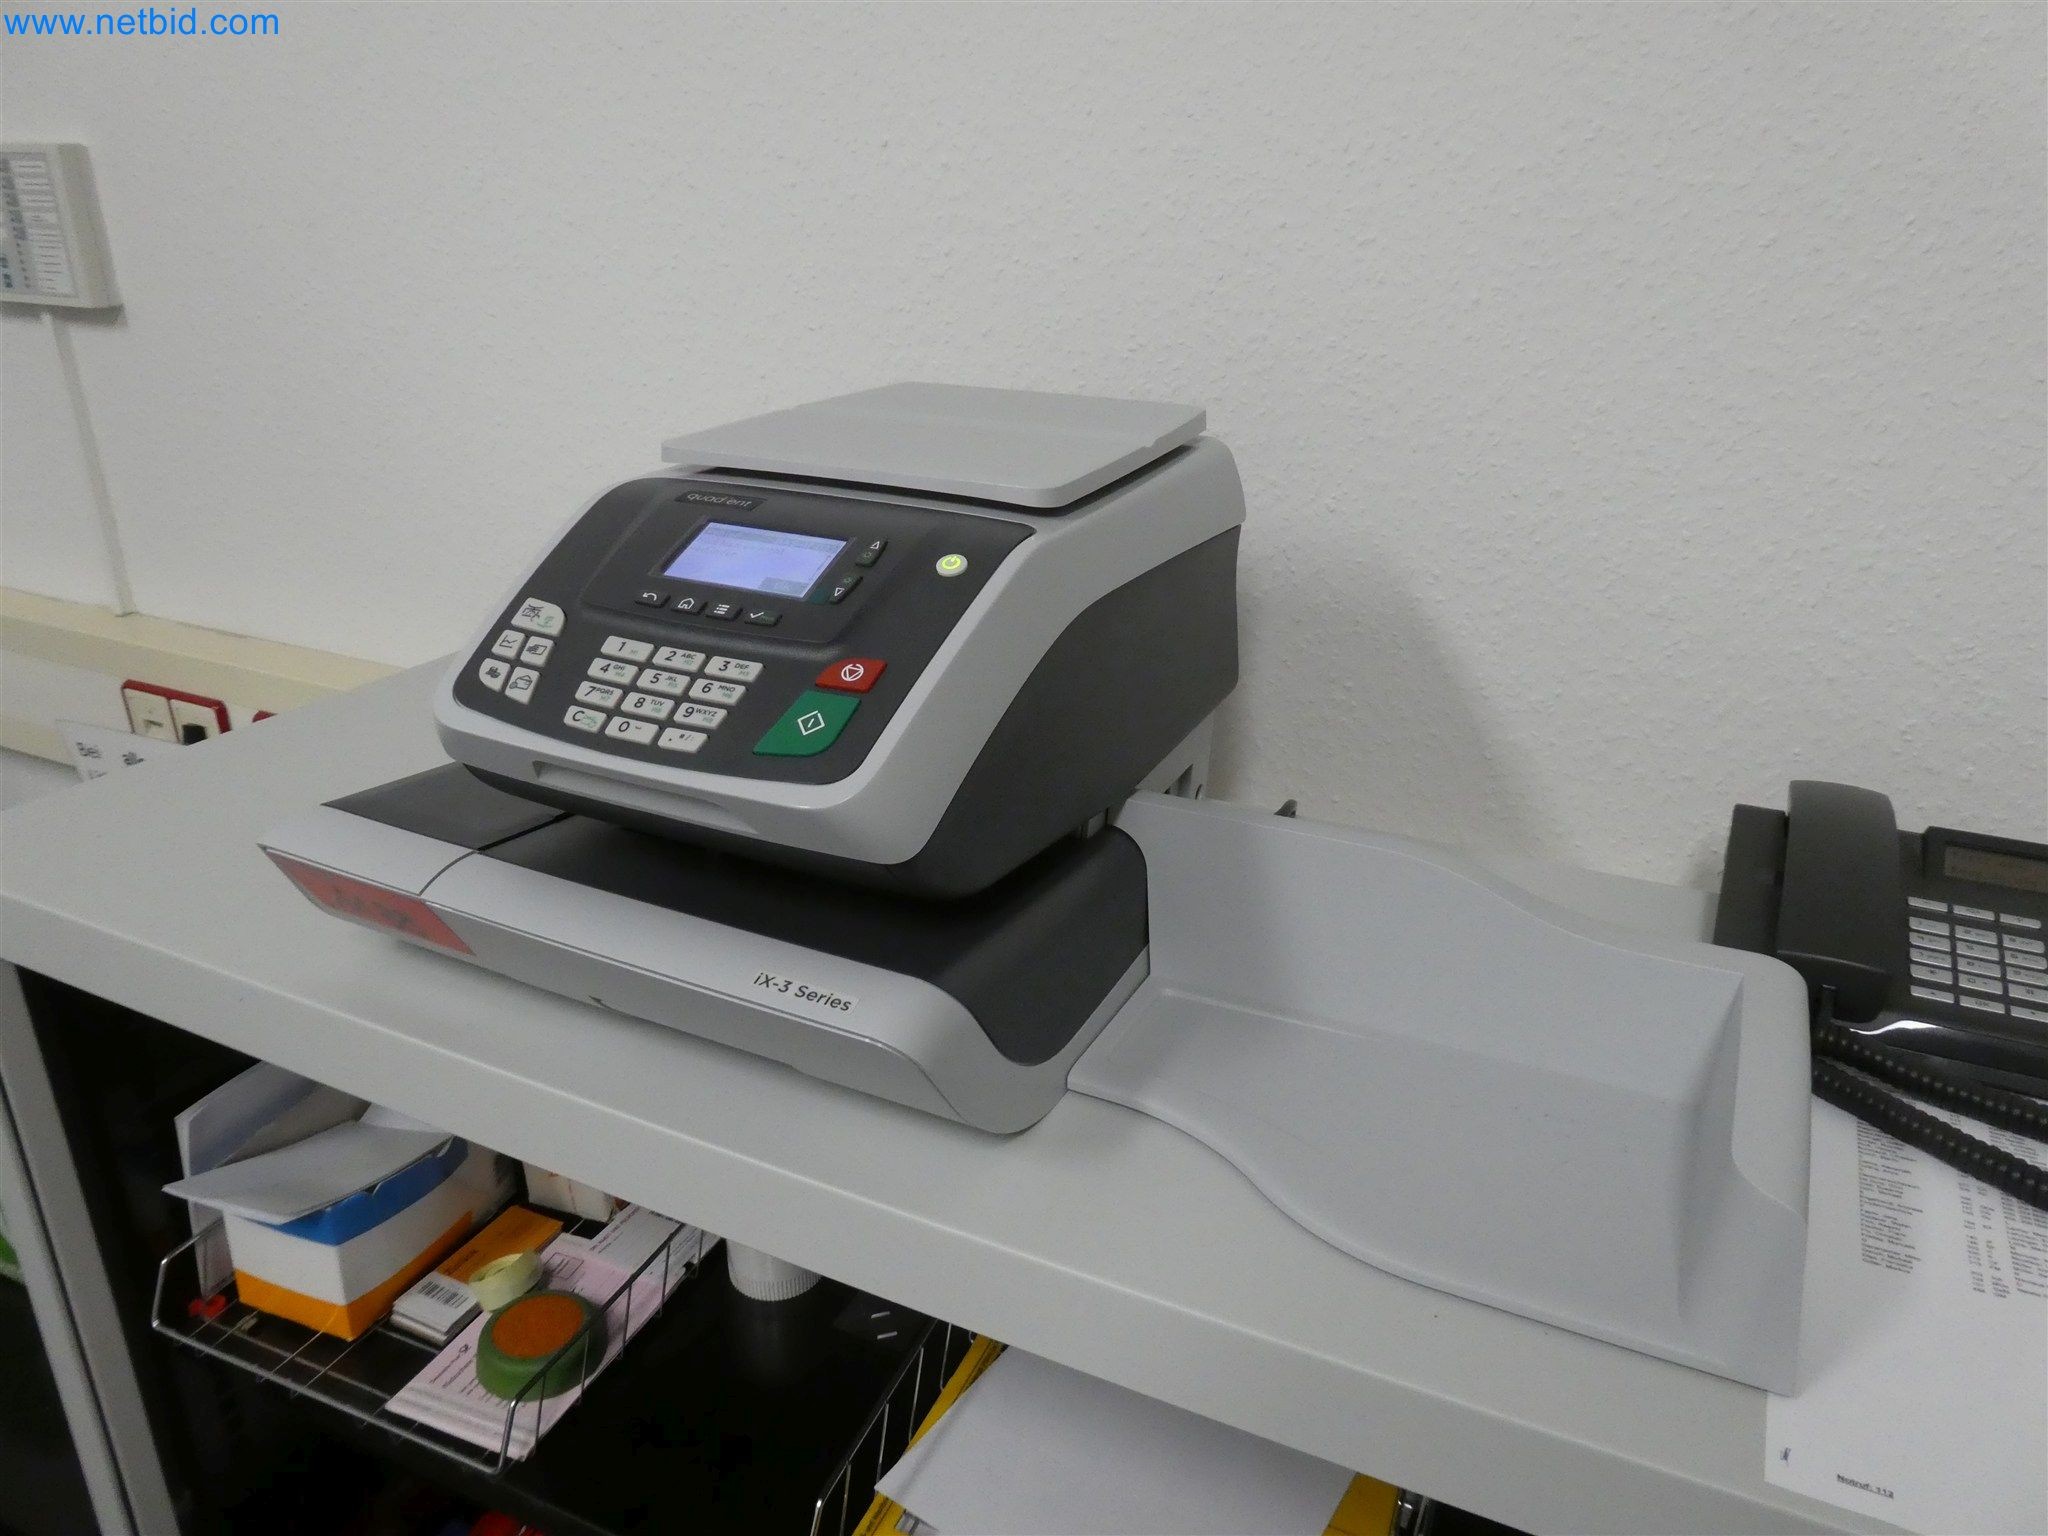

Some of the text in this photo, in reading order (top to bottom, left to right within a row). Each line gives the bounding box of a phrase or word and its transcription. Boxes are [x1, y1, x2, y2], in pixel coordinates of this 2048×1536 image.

[618, 641, 627, 652] 1
[664, 650, 697, 662] 2 ABC
[600, 663, 611, 674] 4
[718, 660, 750, 672] 3 DEF
[650, 672, 662, 684] 5
[584, 685, 597, 697] 7
[701, 682, 714, 694] 6
[634, 697, 646, 708] 8
[572, 710, 585, 722] C
[683, 706, 695, 718] 9
[618, 721, 630, 732] 0
[753, 972, 852, 1011] iX-3 Series
